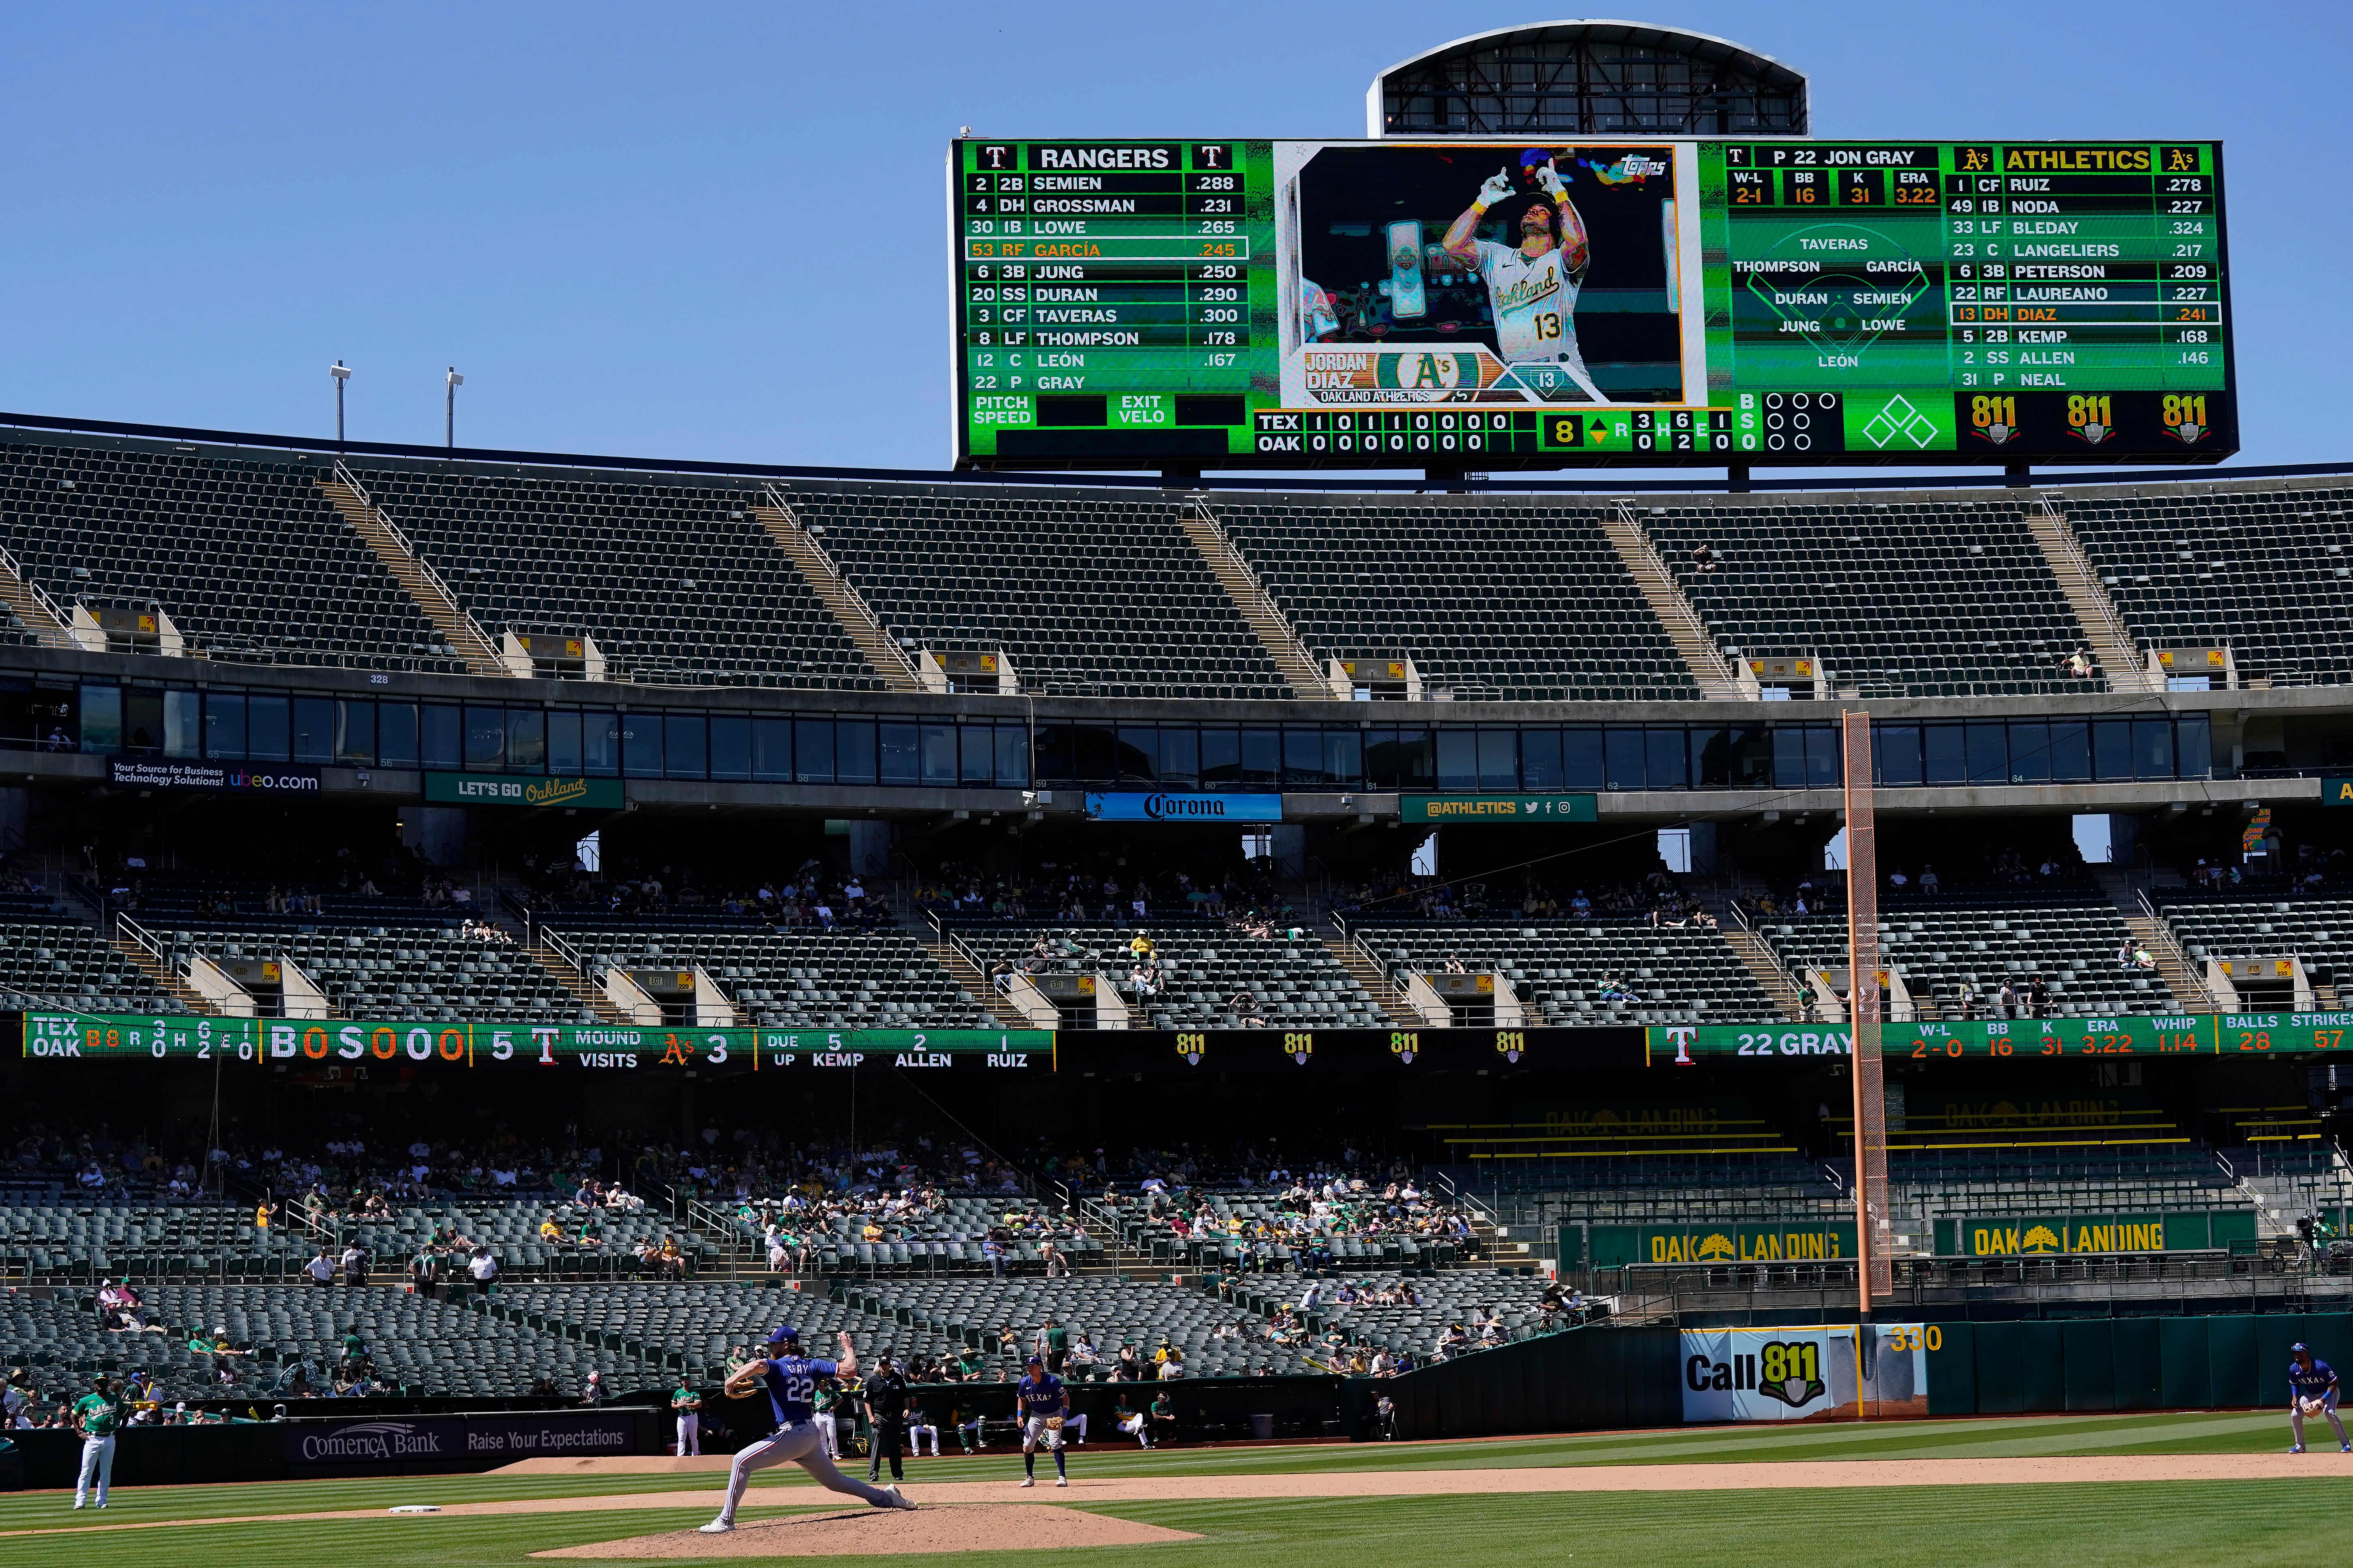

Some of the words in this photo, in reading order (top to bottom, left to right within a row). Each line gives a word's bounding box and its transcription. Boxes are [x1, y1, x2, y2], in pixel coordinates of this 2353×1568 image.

[1041, 149, 1169, 168] RANGERS
[1774, 151, 1786, 164] P
[1794, 150, 1816, 164] 22
[1824, 151, 1861, 164] JON
[1866, 150, 1915, 164] GRAY
[2008, 150, 2149, 169] ATHLETICS
[1034, 177, 1101, 190] SEMIEN
[1196, 177, 1234, 190] .288
[2010, 178, 2050, 191] RUIZ
[2166, 179, 2201, 191] .278
[1034, 199, 1135, 212] GROSSMAN
[1201, 199, 1231, 212] .231
[2012, 201, 2060, 213] NODA
[2168, 201, 2202, 213] .227
[1034, 221, 1086, 234] LOWE
[1198, 221, 1235, 233] .265
[2013, 222, 2078, 234] BLEDAY
[2169, 222, 2203, 234] .324
[1035, 241, 1101, 257] GARCÍA
[1199, 244, 1235, 257] .245
[1800, 239, 1868, 250] TAVERAS
[2014, 244, 2119, 257] LANGELIERS
[2173, 244, 2202, 257] .217
[1035, 266, 1083, 278] JUNG
[1199, 265, 1236, 278] .250
[1733, 261, 1820, 272] THOMPSON
[1866, 258, 1923, 272] GARCÍA
[2015, 265, 2105, 278] PETERSON
[2171, 265, 2207, 278] .209
[1036, 288, 1097, 301] DURAN
[1200, 288, 1237, 301] .290
[1775, 293, 1827, 304] DURAN
[1853, 293, 1911, 304] SEMIEN
[2016, 287, 2108, 300] LAUREANO
[2173, 287, 2207, 300] .227
[1036, 309, 1117, 322] TAVERAS
[1200, 309, 1238, 322] .300
[2018, 308, 2057, 321] DIAZ
[2177, 308, 2206, 320] .241
[1779, 321, 1820, 332] JUNG
[1862, 319, 1905, 331] LOWE
[1036, 332, 1139, 345] THOMPSON
[1203, 332, 1235, 345] .178
[2018, 330, 2067, 343] KEMP
[2177, 330, 2207, 343] .168
[1038, 351, 1084, 367] LEÓN
[1204, 353, 1236, 366] .167
[1305, 353, 1367, 371] JORDAN
[1819, 356, 1858, 367] LEÓN
[2019, 352, 2075, 364] ALLEN
[2178, 351, 2208, 364] .146
[1038, 376, 1085, 389] GRAY
[1307, 372, 1354, 389] DIAZ
[2021, 373, 2066, 386] NEAL
[976, 396, 1028, 409] PITCH
[1122, 396, 1161, 408] EXIT
[1321, 391, 1371, 402] OAKLAND
[1373, 390, 1430, 402] ATHLETICS
[1119, 410, 1165, 423] VELO
[1972, 396, 2015, 427] 811
[2068, 395, 2111, 426] 811
[2163, 395, 2206, 426] 811
[974, 411, 1031, 424] SPEED
[1259, 415, 1298, 429] TEX
[1259, 436, 1300, 451] OAK
[370, 675, 388, 684] 328
[207, 750, 219, 758] 55
[381, 758, 393, 767] 56
[114, 763, 135, 771] Your
[137, 764, 167, 773] Source
[169, 765, 183, 774] for
[184, 766, 223, 776] Business
[550, 767, 562, 775] 57
[114, 773, 172, 786] Technology
[174, 775, 223, 786] Solutions!
[231, 769, 317, 789] ubeo.com
[502, 784, 521, 797] GO
[526, 778, 586, 805] Oakland
[1607, 782, 1618, 790] 62
[1144, 793, 1226, 819] Corona
[1427, 802, 1516, 816] @ATHLETICS
[32, 1017, 78, 1036] TEX
[1919, 1024, 1951, 1036] W-L
[1987, 1023, 2008, 1035] BB
[2042, 1022, 2053, 1033] K
[2088, 1020, 2119, 1032] ERA
[2152, 1017, 2196, 1030] WHIP
[2227, 1015, 2278, 1028] BALLS
[576, 1030, 641, 1045] MOUND
[768, 1036, 798, 1047] DUE
[1177, 1033, 1204, 1054] 811
[1285, 1032, 1312, 1054] 811
[1391, 1032, 1418, 1053] 811
[1496, 1031, 1524, 1052] 811
[1738, 1033, 1773, 1055] 22
[1780, 1030, 1852, 1055] GRAY
[2240, 1032, 2270, 1050] 28
[2314, 1030, 2344, 1048] 57
[33, 1037, 81, 1057] OAK
[492, 1031, 513, 1060] 5
[1991, 1038, 2013, 1056] 16
[2042, 1037, 2062, 1055] 31
[2082, 1035, 2133, 1054] 3.22
[2160, 1033, 2197, 1051] 1.14
[579, 1053, 637, 1068] VISITS
[775, 1054, 795, 1065] UP
[813, 1053, 864, 1067] KEMP
[895, 1054, 951, 1067] ALLEN
[987, 1054, 1027, 1067] RUIZ
[1975, 1228, 2018, 1255] OAK
[2063, 1223, 2162, 1253] LANDING
[1652, 1235, 1699, 1263] OAK
[1740, 1232, 1839, 1261] LANDING
[1890, 1326, 1942, 1352] 330
[787, 1364, 809, 1374] GRAY
[1686, 1354, 1756, 1391] Call
[1765, 1345, 1816, 1382] 811
[787, 1377, 814, 1403] 22
[1026, 1393, 1051, 1402] TEXAS
[393, 1431, 441, 1454] Bank
[468, 1433, 504, 1450] Raise
[508, 1431, 538, 1449] Your
[541, 1428, 624, 1450] Expectations
